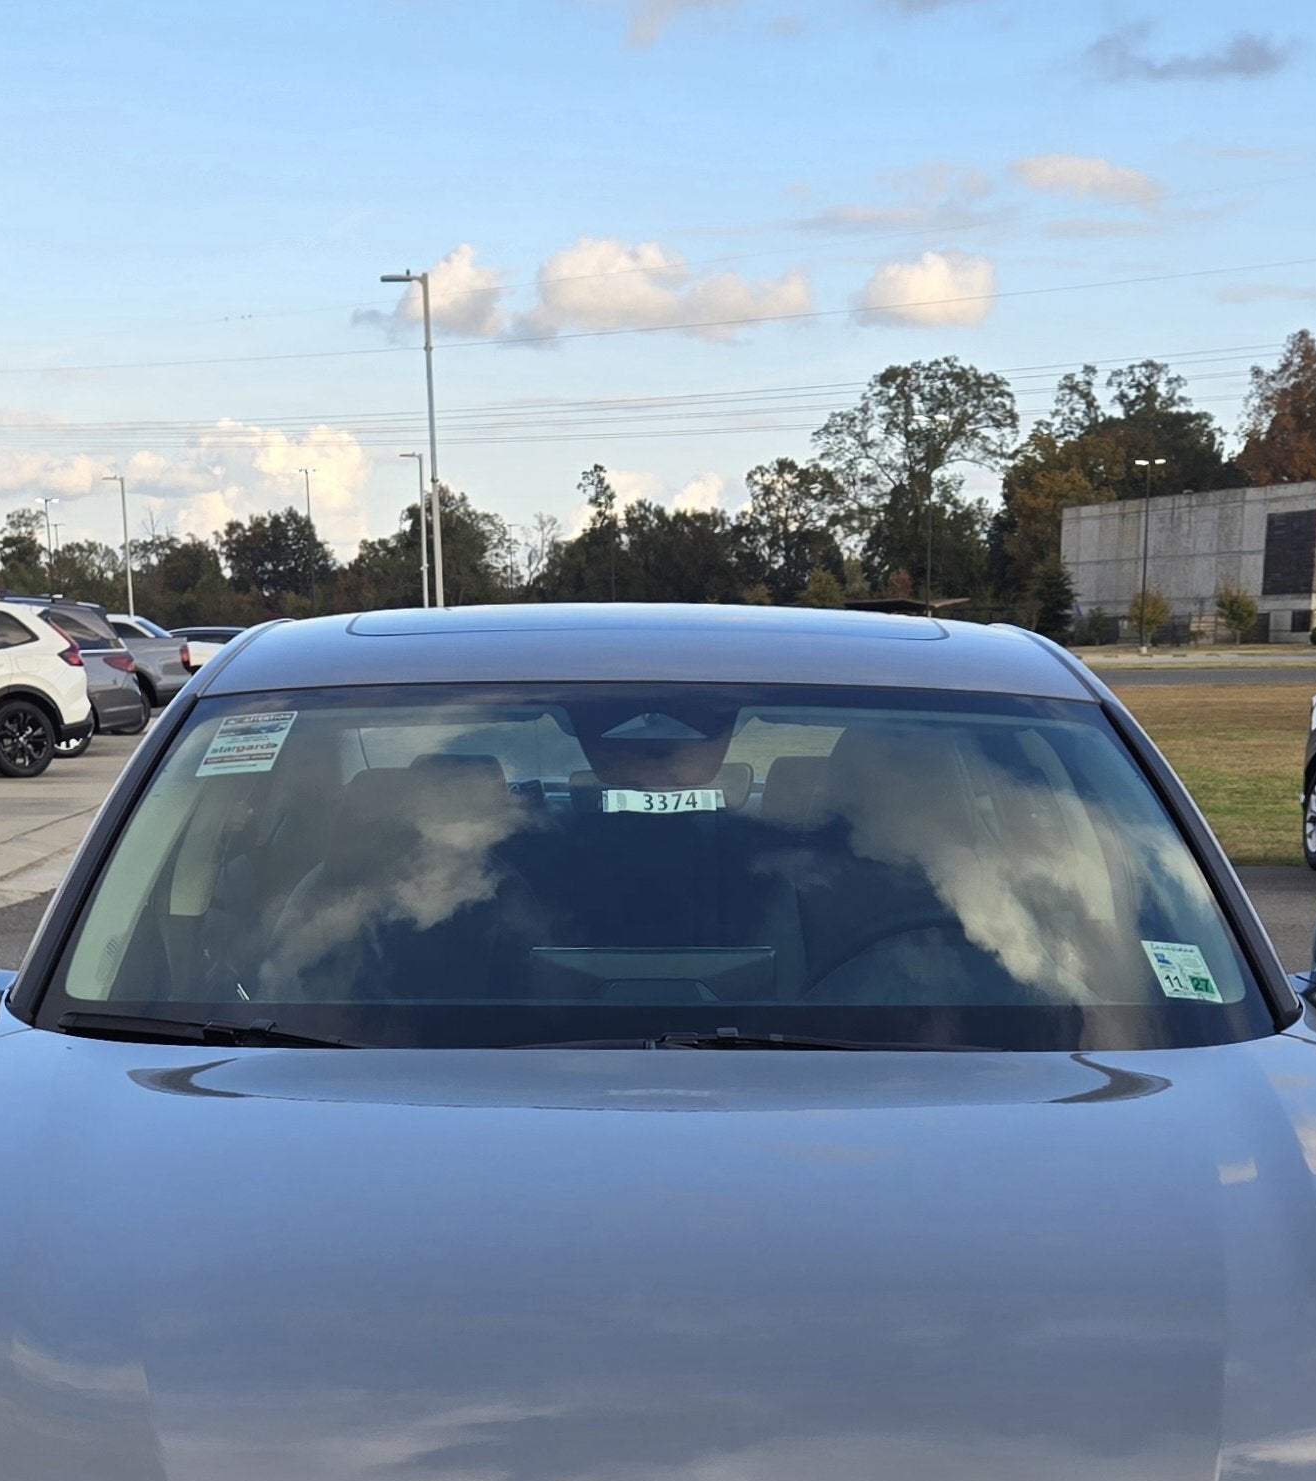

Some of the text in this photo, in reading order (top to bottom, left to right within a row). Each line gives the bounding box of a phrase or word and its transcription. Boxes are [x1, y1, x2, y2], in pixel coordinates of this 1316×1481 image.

[643, 791, 698, 811] 3374
[1165, 974, 1211, 993] 11 27
